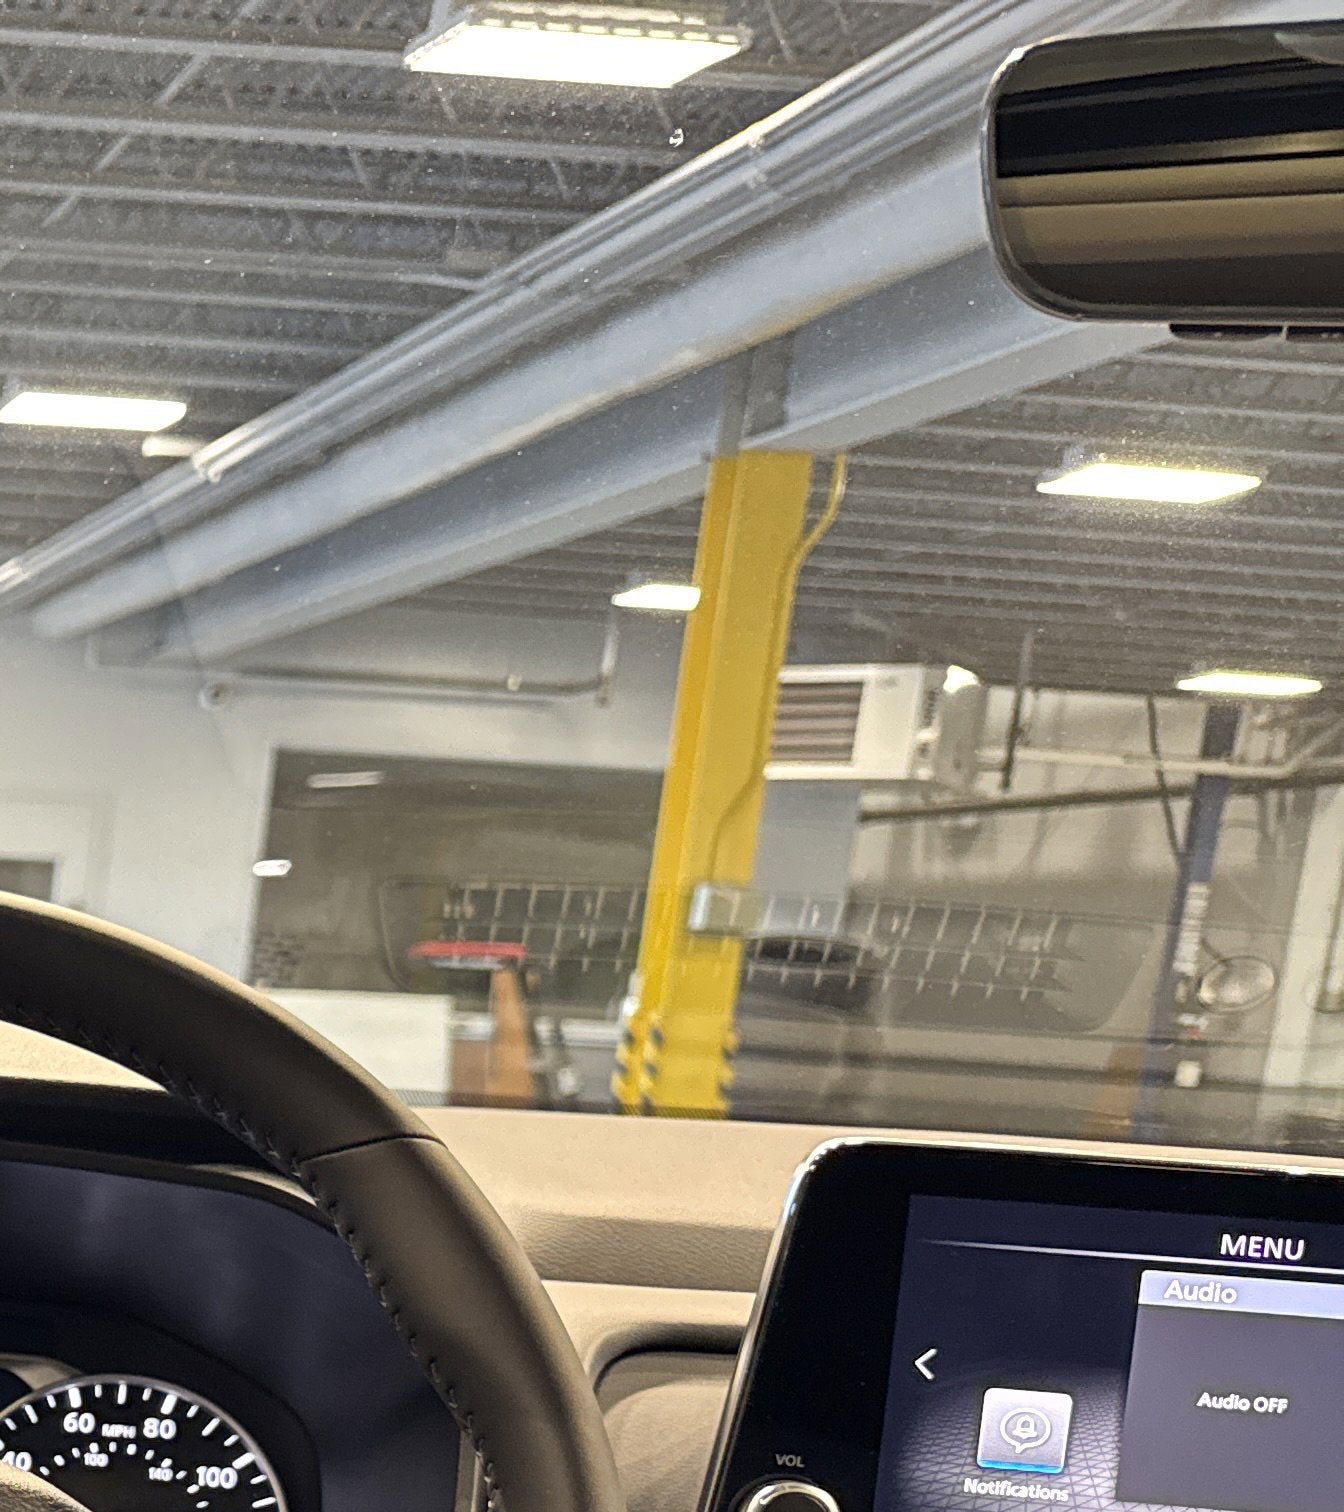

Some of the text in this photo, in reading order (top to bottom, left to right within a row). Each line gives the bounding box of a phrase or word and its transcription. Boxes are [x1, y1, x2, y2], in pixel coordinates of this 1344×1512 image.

[1220, 1233, 1304, 1260] MENU
[1163, 1278, 1238, 1305] Audio
[1196, 1392, 1289, 1414] Audio OFF
[63, 1411, 96, 1434] 60
[101, 1423, 137, 1439] MPH
[142, 1417, 177, 1440] 80
[84, 1453, 109, 1467] 100
[775, 1454, 805, 1468] VOL
[148, 1466, 174, 1482] 140
[196, 1465, 239, 1489] 100
[963, 1477, 1070, 1502] Notifications
